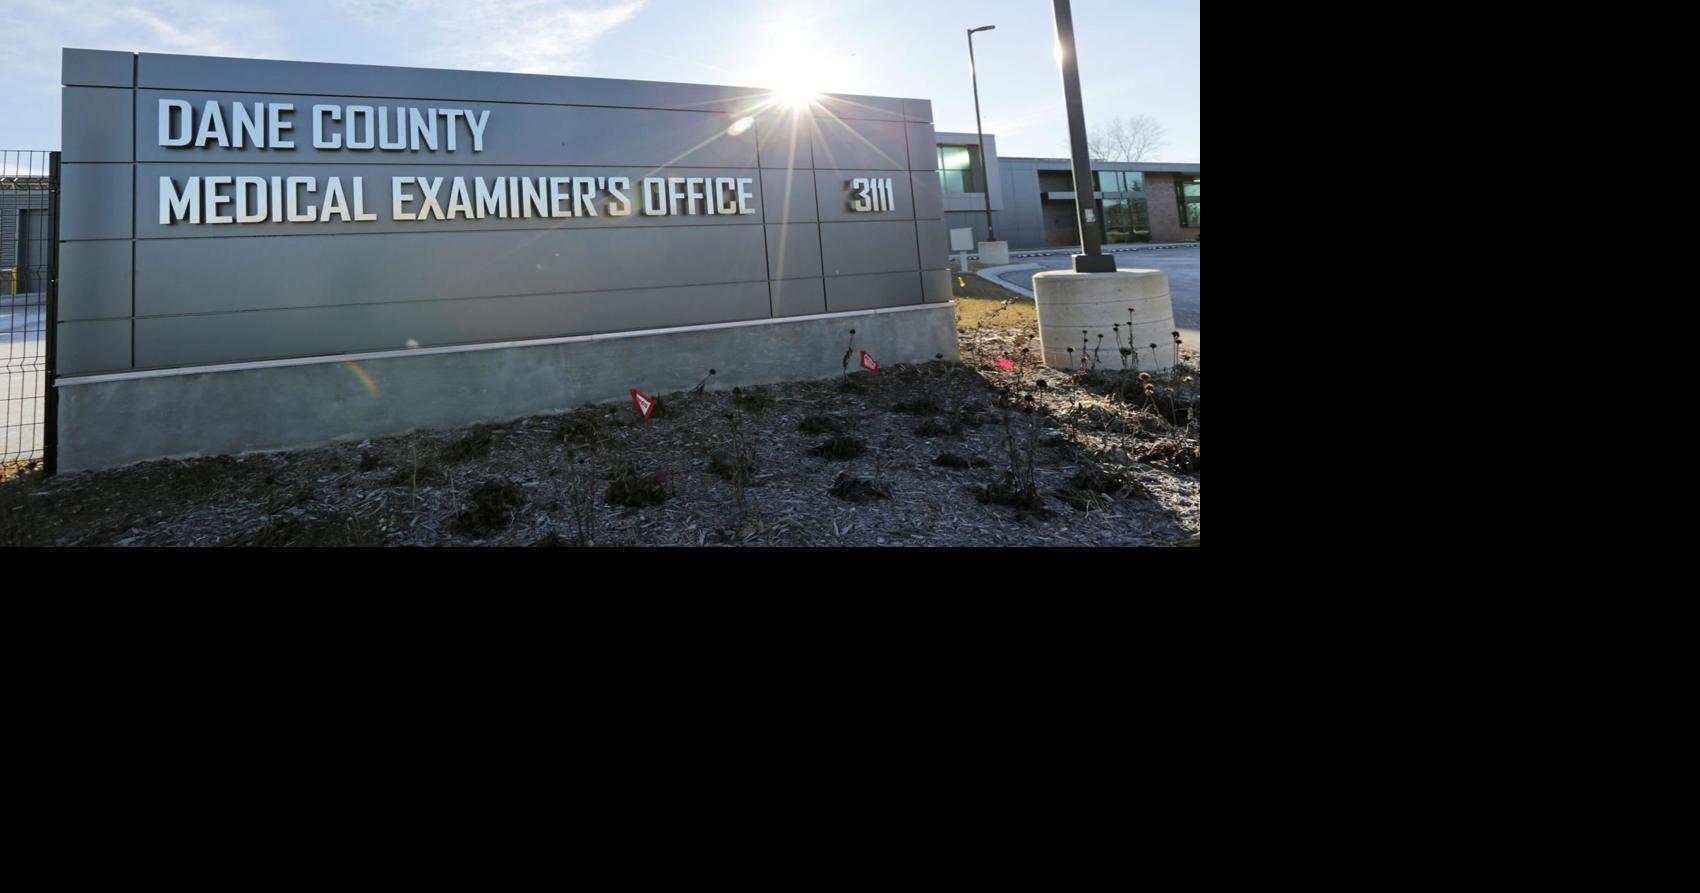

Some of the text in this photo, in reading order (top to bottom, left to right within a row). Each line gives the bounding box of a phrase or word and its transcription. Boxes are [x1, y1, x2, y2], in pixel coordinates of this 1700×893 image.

[158, 98, 490, 152] DANE COUNTY
[159, 175, 755, 225] MEDICAL EXAMINER'S OFFICE
[852, 177, 895, 212] 3111
